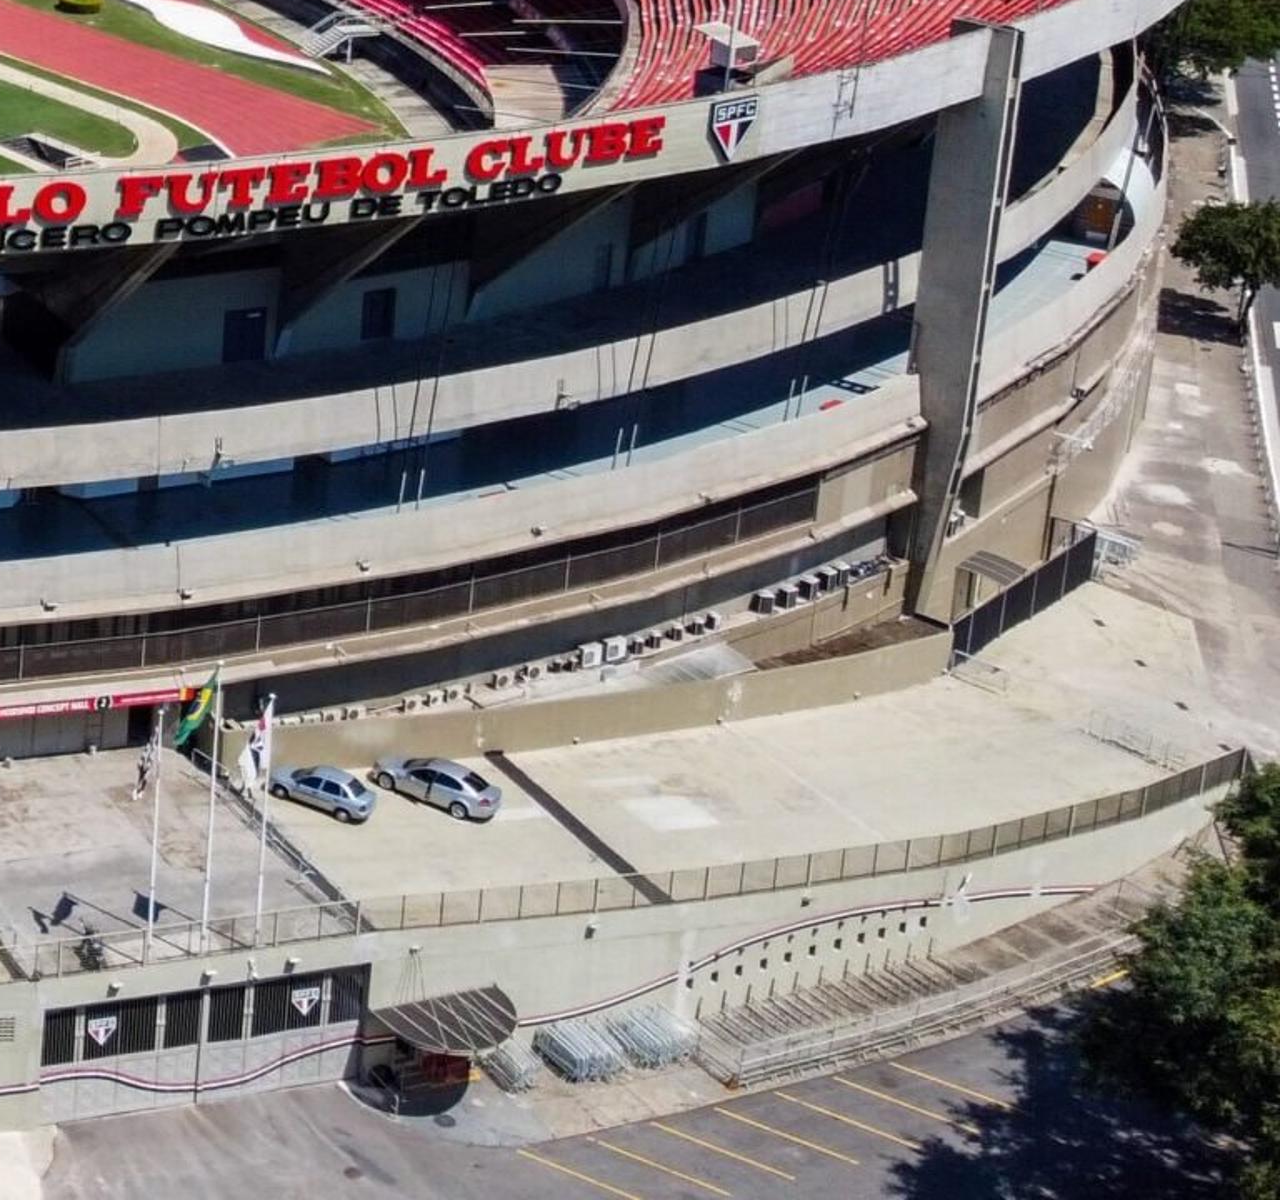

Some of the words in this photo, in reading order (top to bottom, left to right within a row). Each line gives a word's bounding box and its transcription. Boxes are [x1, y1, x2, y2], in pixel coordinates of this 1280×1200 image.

[718, 102, 756, 121] SPFC
[117, 148, 447, 215] FUTEBOL
[469, 116, 666, 178] CLUBE
[155, 202, 330, 240] POMPEU
[350, 194, 403, 220] DE
[418, 173, 562, 211] TOLEDO
